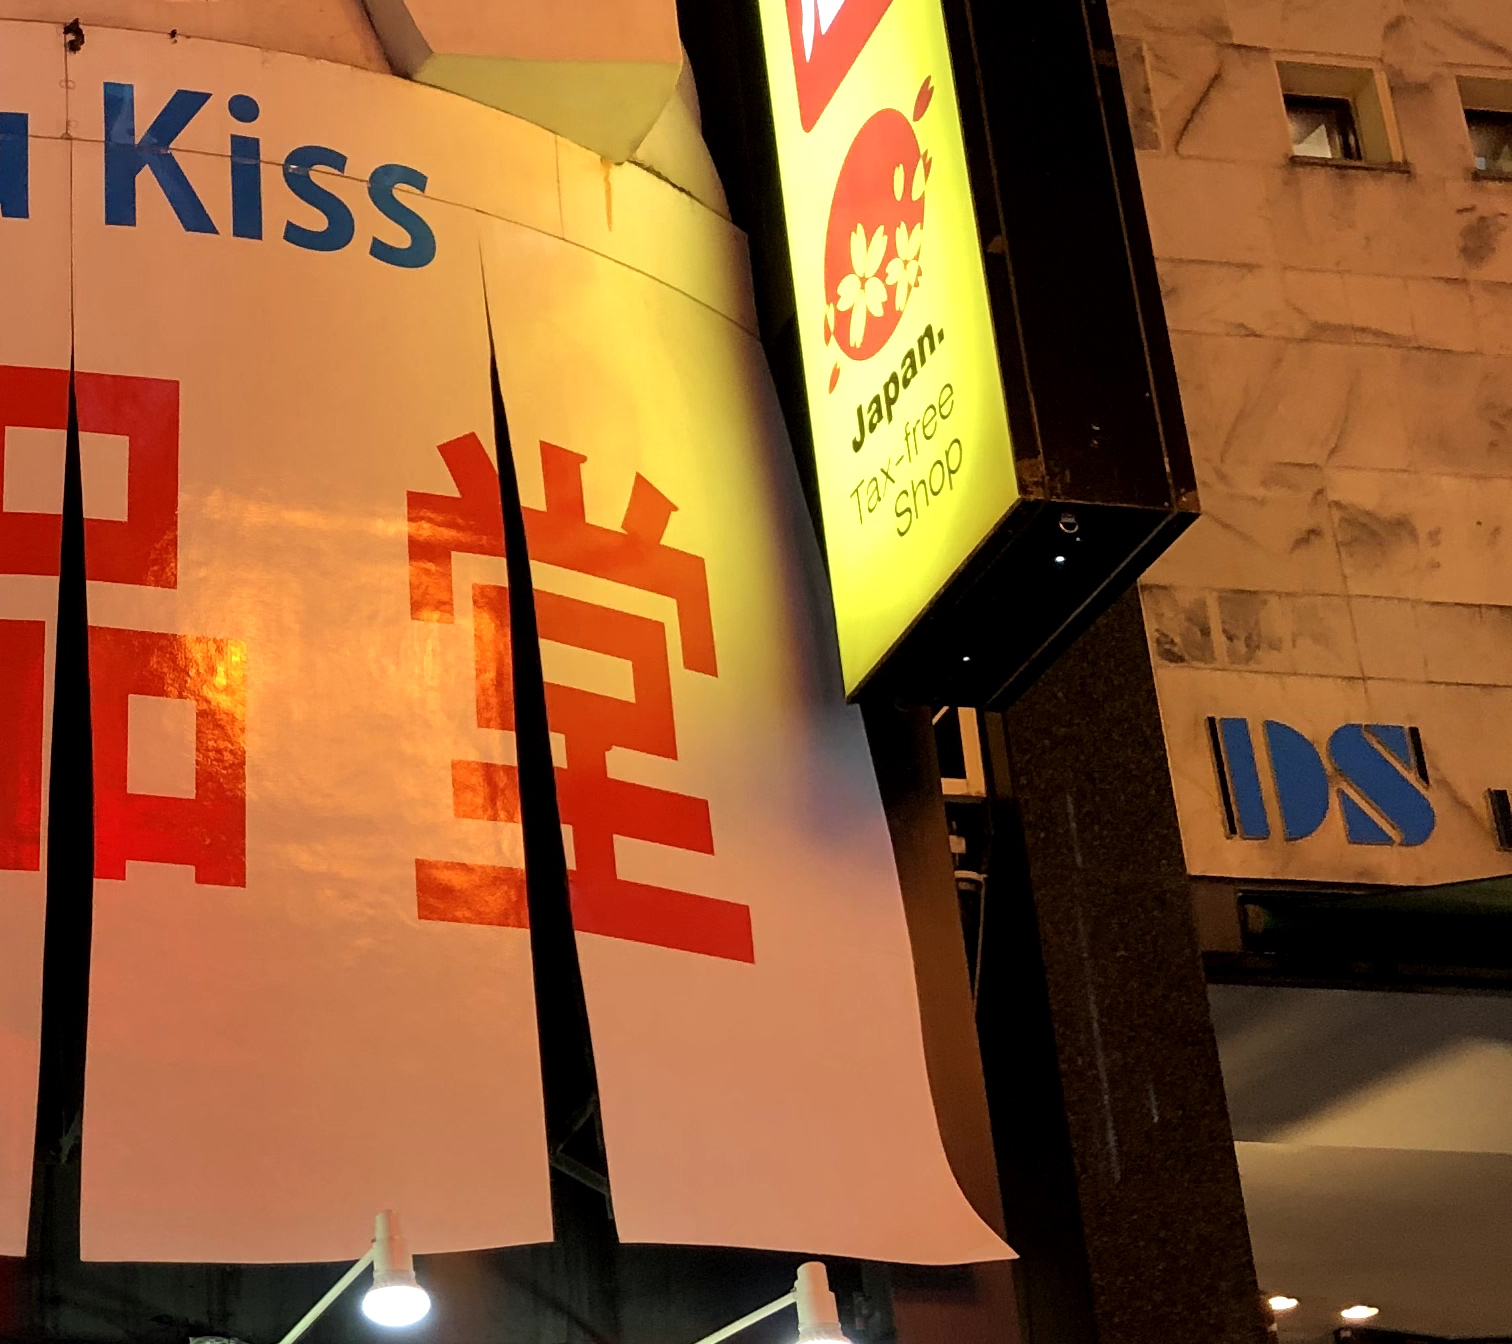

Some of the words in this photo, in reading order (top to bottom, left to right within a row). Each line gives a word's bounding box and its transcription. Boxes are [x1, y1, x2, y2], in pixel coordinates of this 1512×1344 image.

[102, 82, 440, 271] Kiss
[850, 383, 957, 526] Tax-free
[851, 322, 945, 453] Japan.
[894, 436, 963, 538] Shop
